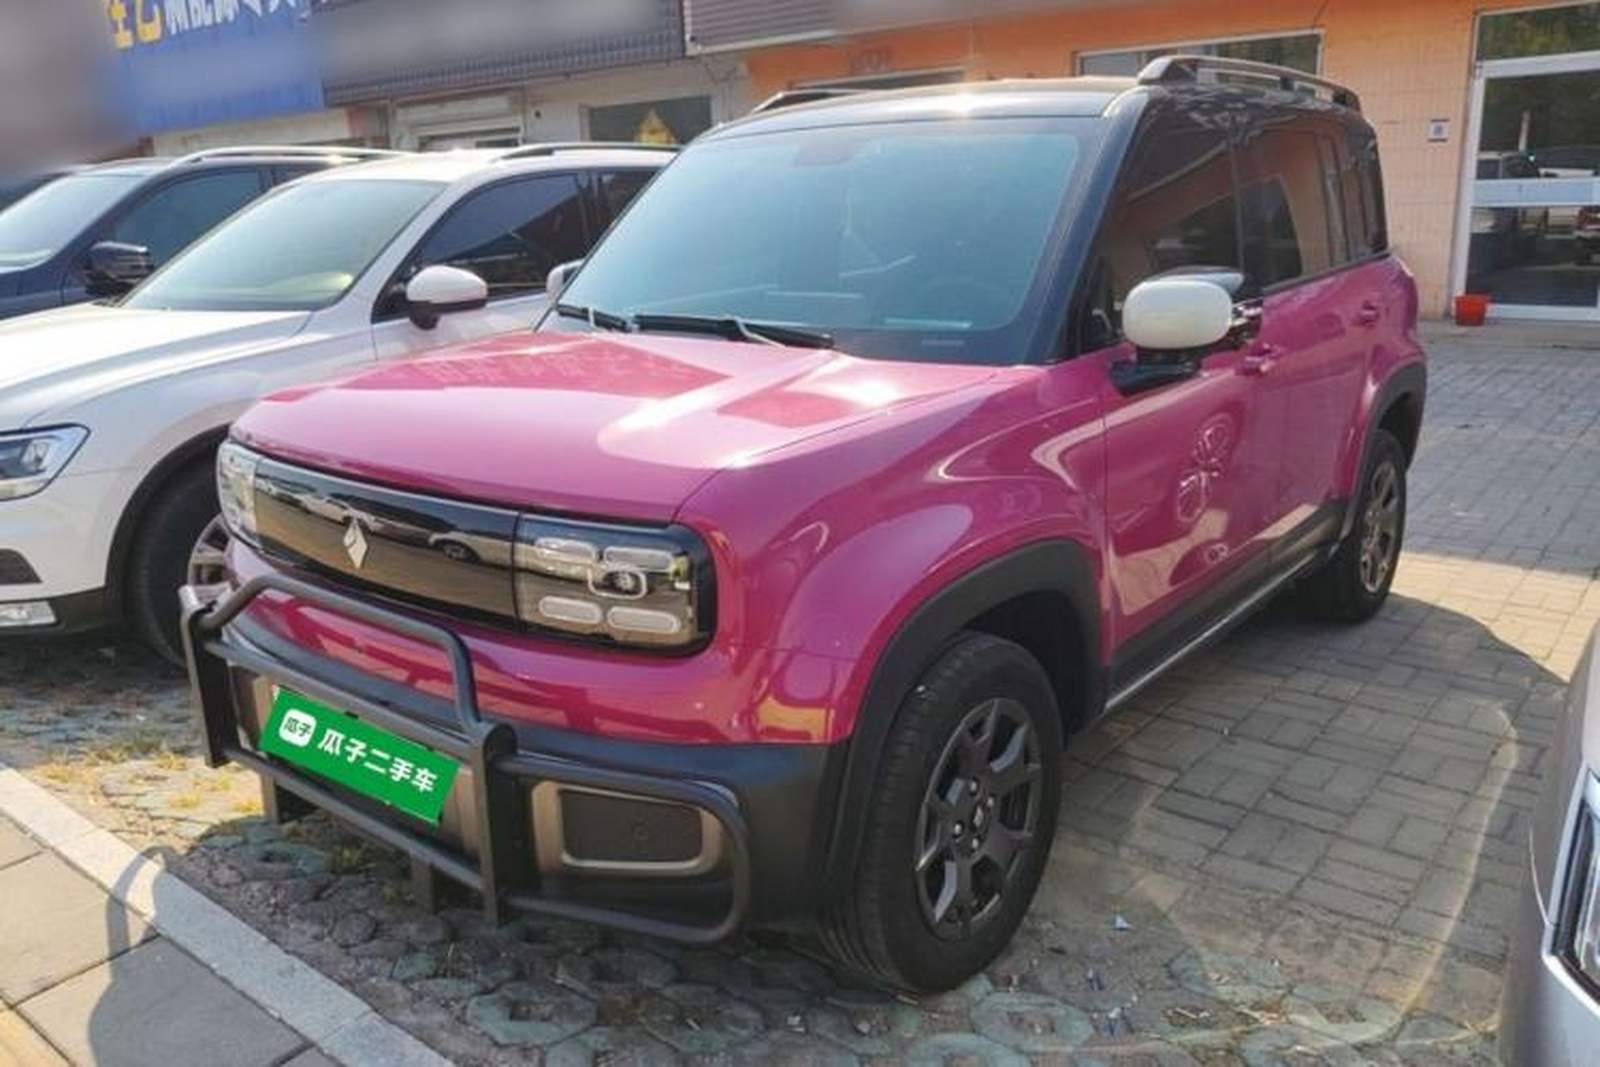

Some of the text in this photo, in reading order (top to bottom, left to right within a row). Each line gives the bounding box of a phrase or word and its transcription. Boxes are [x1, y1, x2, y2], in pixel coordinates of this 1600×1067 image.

[283, 716, 312, 737] 瓜子
[317, 728, 438, 792] 瓜子二手车
